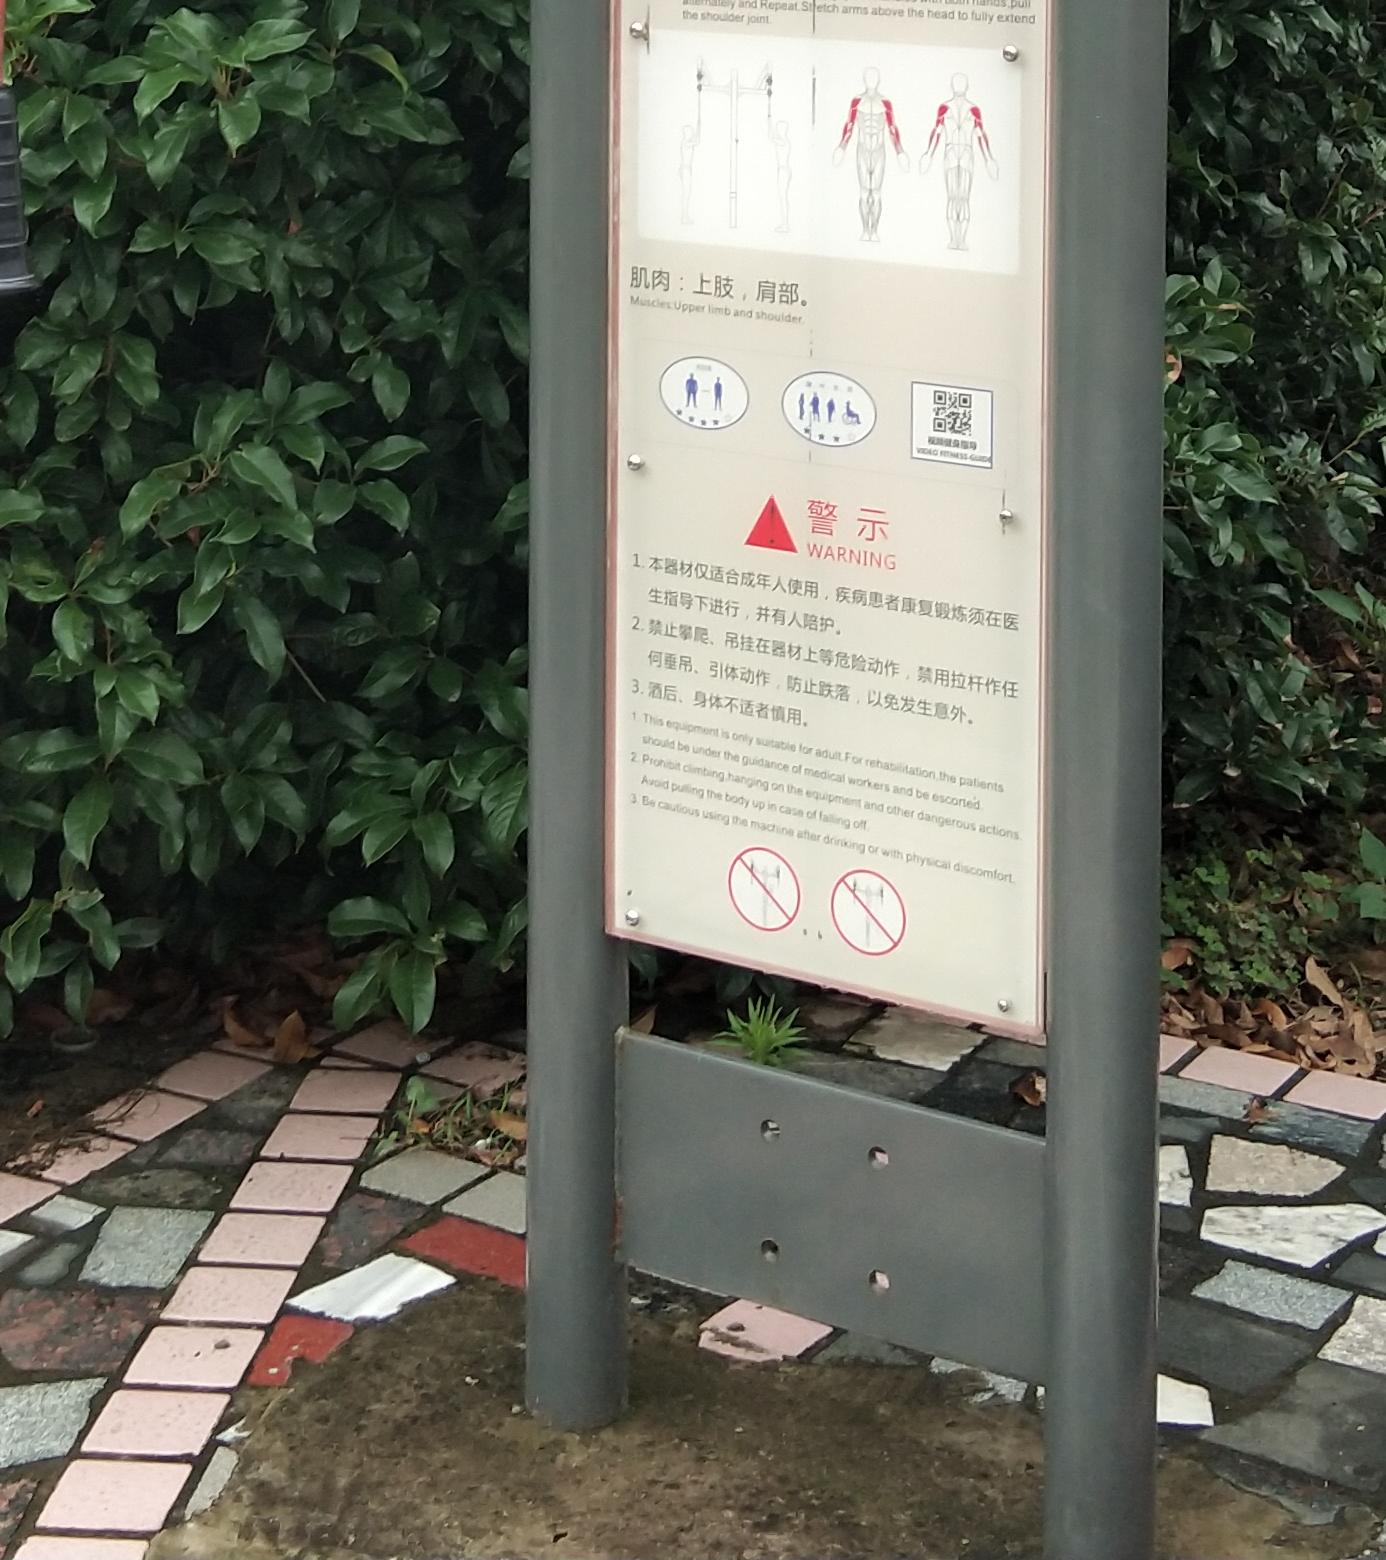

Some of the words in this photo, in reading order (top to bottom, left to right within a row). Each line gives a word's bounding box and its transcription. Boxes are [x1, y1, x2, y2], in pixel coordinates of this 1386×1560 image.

[683, 10, 698, 20] the
[701, 11, 744, 23] shoulder
[739, 0, 757, 9] and
[842, 6, 868, 15] arms
[872, 7, 904, 17] above
[908, 8, 924, 18] the
[928, 9, 954, 19] head
[958, 11, 968, 20] to
[972, 12, 994, 24] fully
[997, 13, 1035, 24] extend
[708, 305, 731, 316] limb
[734, 308, 752, 318] and
[807, 500, 889, 541] 警示
[807, 543, 896, 570] WARNING
[643, 713, 663, 726] This
[666, 719, 718, 737] equipment
[722, 730, 729, 739] is
[732, 731, 753, 745] only
[756, 735, 796, 752] suitable
[799, 743, 813, 755] for
[960, 776, 1004, 793] patients
[643, 734, 675, 750] should
[678, 742, 689, 752] be
[693, 745, 721, 757] under
[724, 751, 739, 762] the
[742, 754, 789, 771] guidance
[792, 764, 802, 773] of
[805, 766, 845, 783] medical
[848, 776, 889, 792] workers
[893, 785, 912, 796] and
[916, 789, 929, 800] be
[641, 775, 669, 789] Avoid
[672, 781, 704, 799] pulling
[707, 789, 722, 800] the
[726, 792, 749, 808] body
[753, 799, 765, 810] up
[768, 802, 776, 812] in
[779, 805, 803, 817] case
[806, 808, 817, 819] of
[820, 811, 850, 829] falling
[643, 754, 680, 771] Prohibit
[772, 781, 785, 791] on
[788, 784, 803, 795] the
[806, 789, 861, 808] equipment
[864, 797, 884, 812] and
[887, 802, 914, 818] other
[918, 810, 976, 831] dangerous
[642, 796, 655, 807] Be
[658, 800, 699, 817] cautious
[703, 810, 730, 826] using
[733, 815, 748, 827] the
[751, 820, 794, 837] machine
[797, 828, 820, 842] after
[823, 836, 865, 854] drinking
[868, 844, 879, 854] or
[882, 847, 903, 860] with
[906, 852, 951, 869] physical
